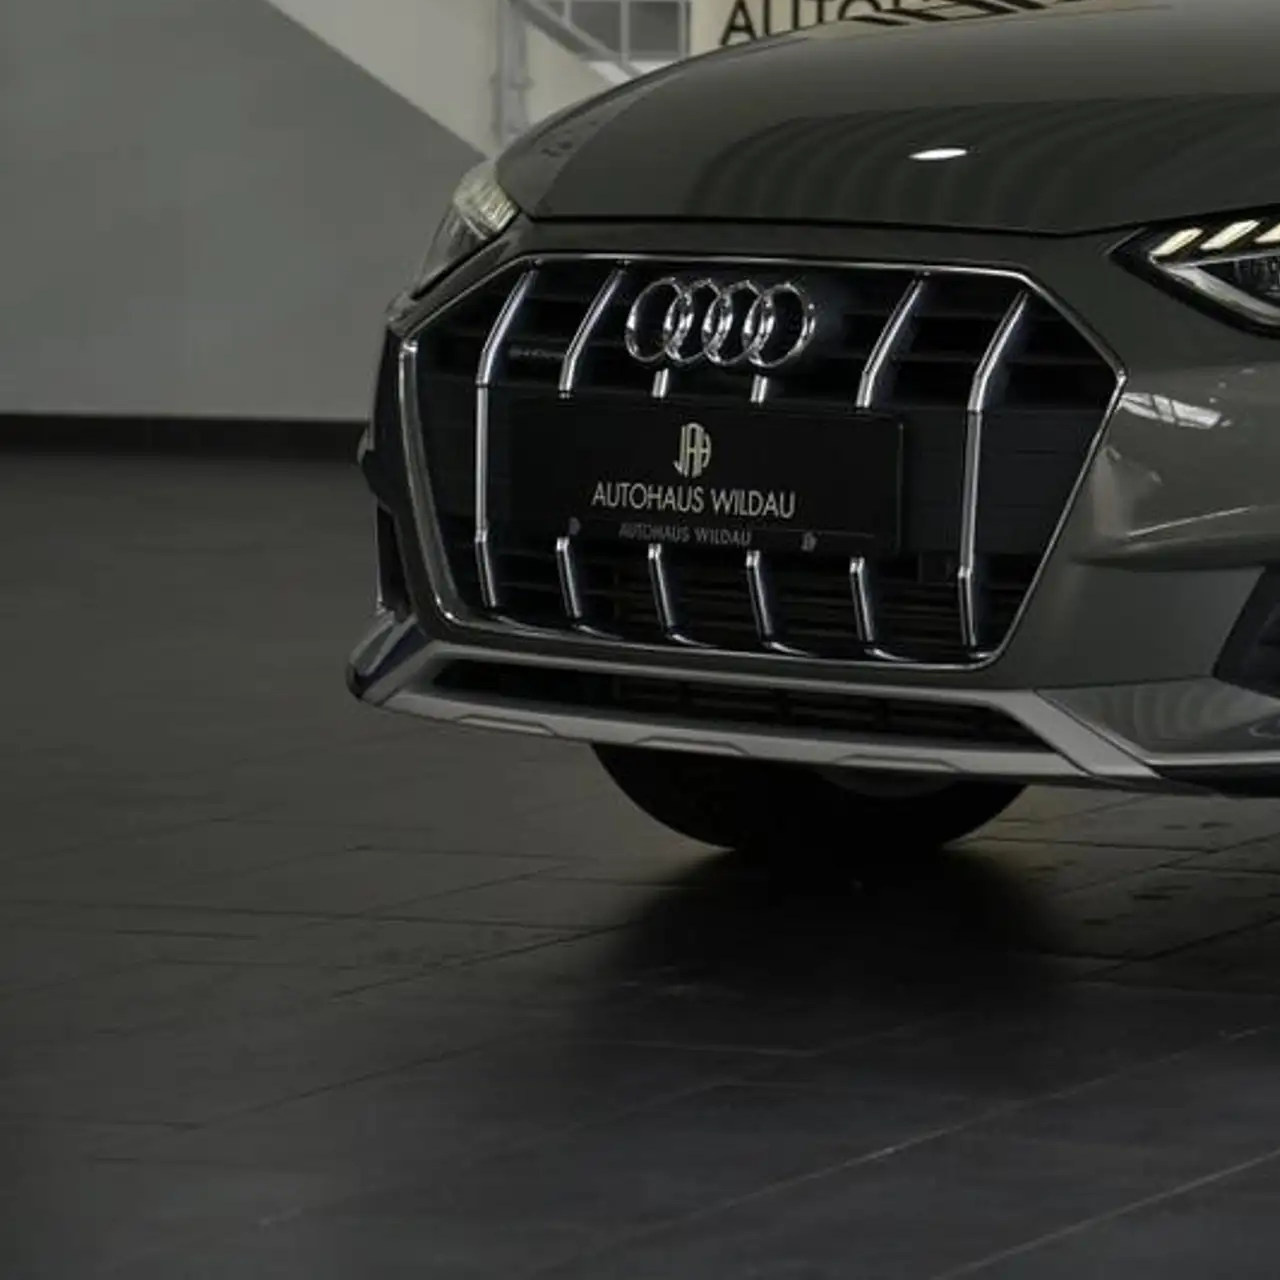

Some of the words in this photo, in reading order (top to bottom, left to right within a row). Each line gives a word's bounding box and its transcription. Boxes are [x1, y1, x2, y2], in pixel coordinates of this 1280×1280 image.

[591, 482, 705, 514] AUTOHAUS
[711, 488, 796, 519] WILDAU
[619, 523, 690, 544] AUTOHAUS
[694, 527, 752, 546] WILDAU
